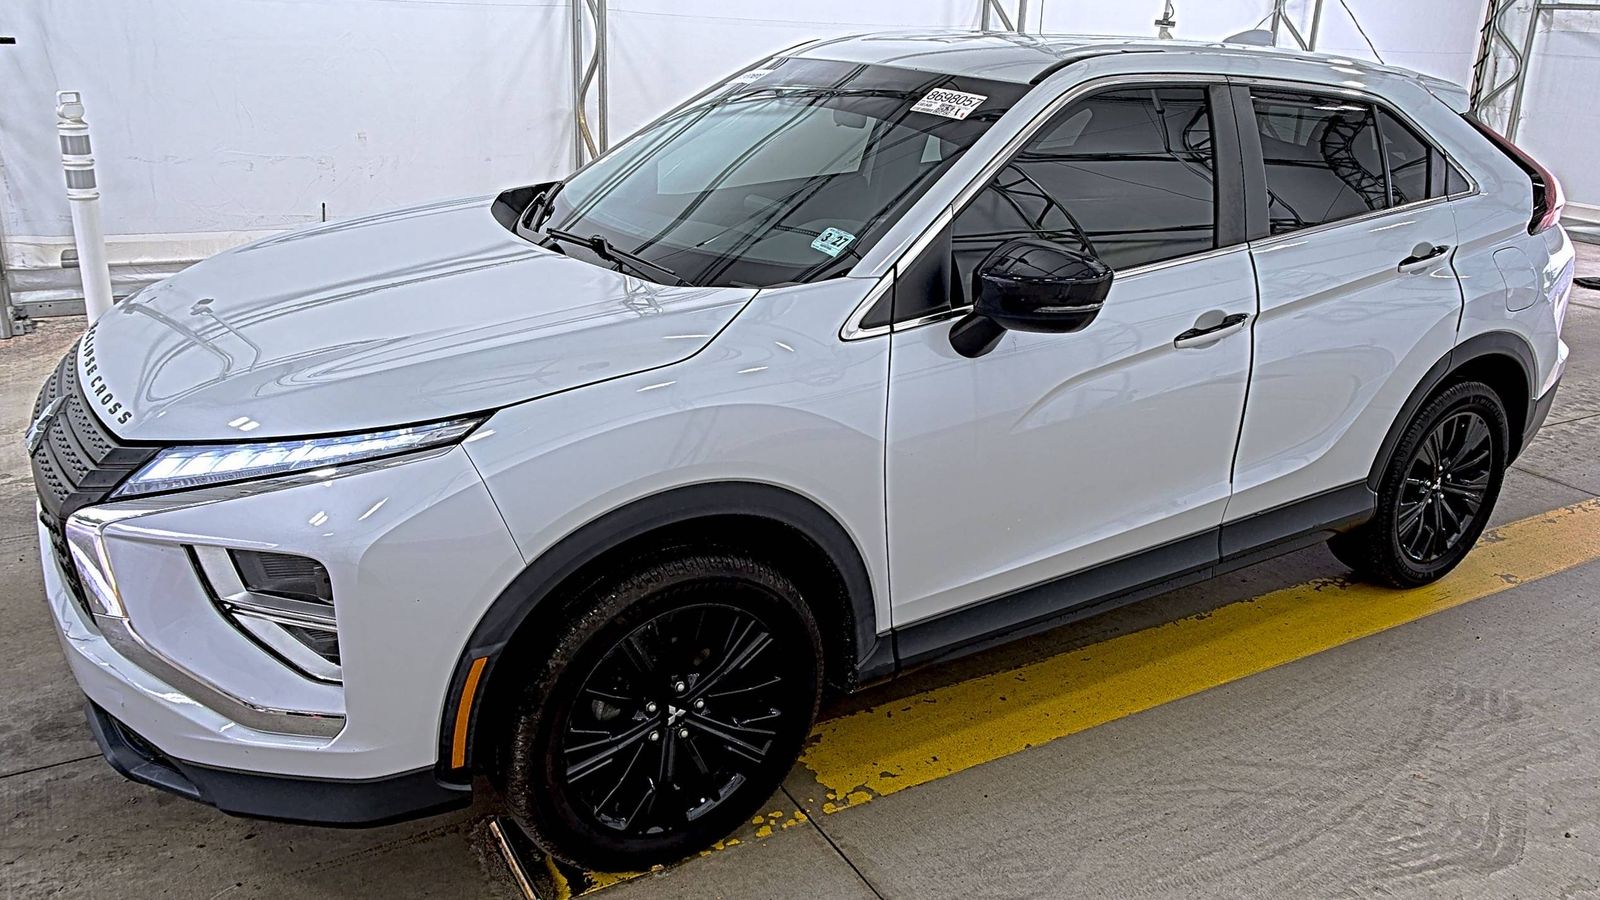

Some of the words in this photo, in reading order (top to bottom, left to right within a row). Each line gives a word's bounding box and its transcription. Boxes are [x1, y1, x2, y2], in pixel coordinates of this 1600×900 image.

[926, 91, 984, 108] 8698057
[821, 232, 832, 242] 3
[831, 236, 848, 247] 27
[90, 375, 133, 425] CROSS
